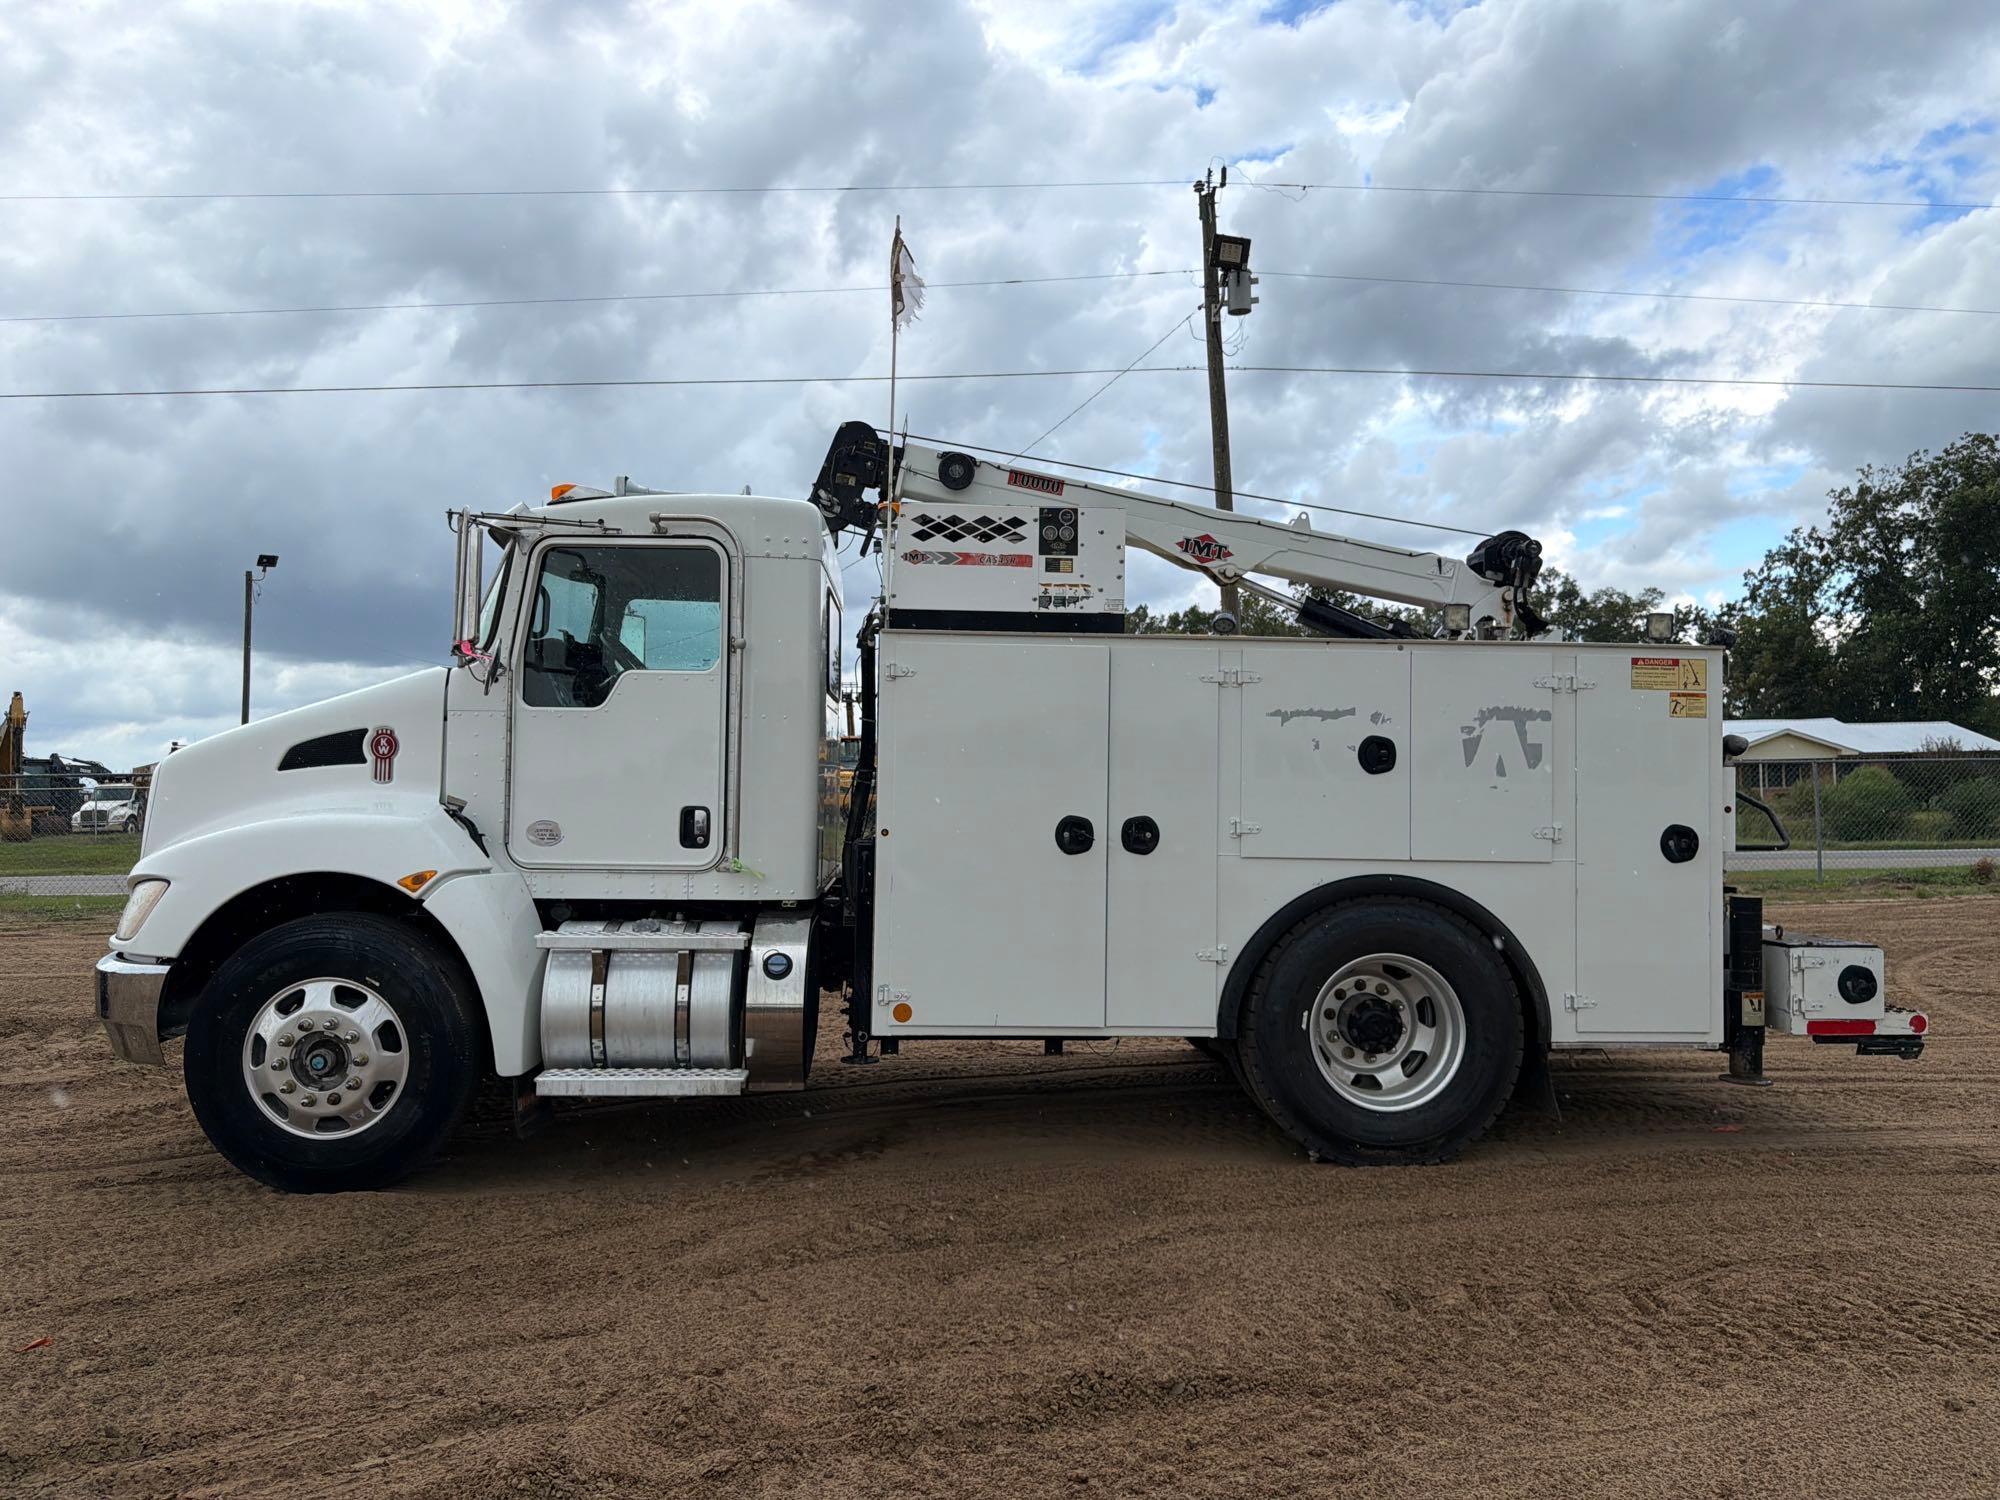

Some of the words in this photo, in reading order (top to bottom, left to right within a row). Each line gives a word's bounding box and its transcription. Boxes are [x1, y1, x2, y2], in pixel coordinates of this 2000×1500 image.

[1012, 471, 1060, 493] 10000
[902, 552, 926, 561] IMT
[1182, 537, 1228, 561] IMT
